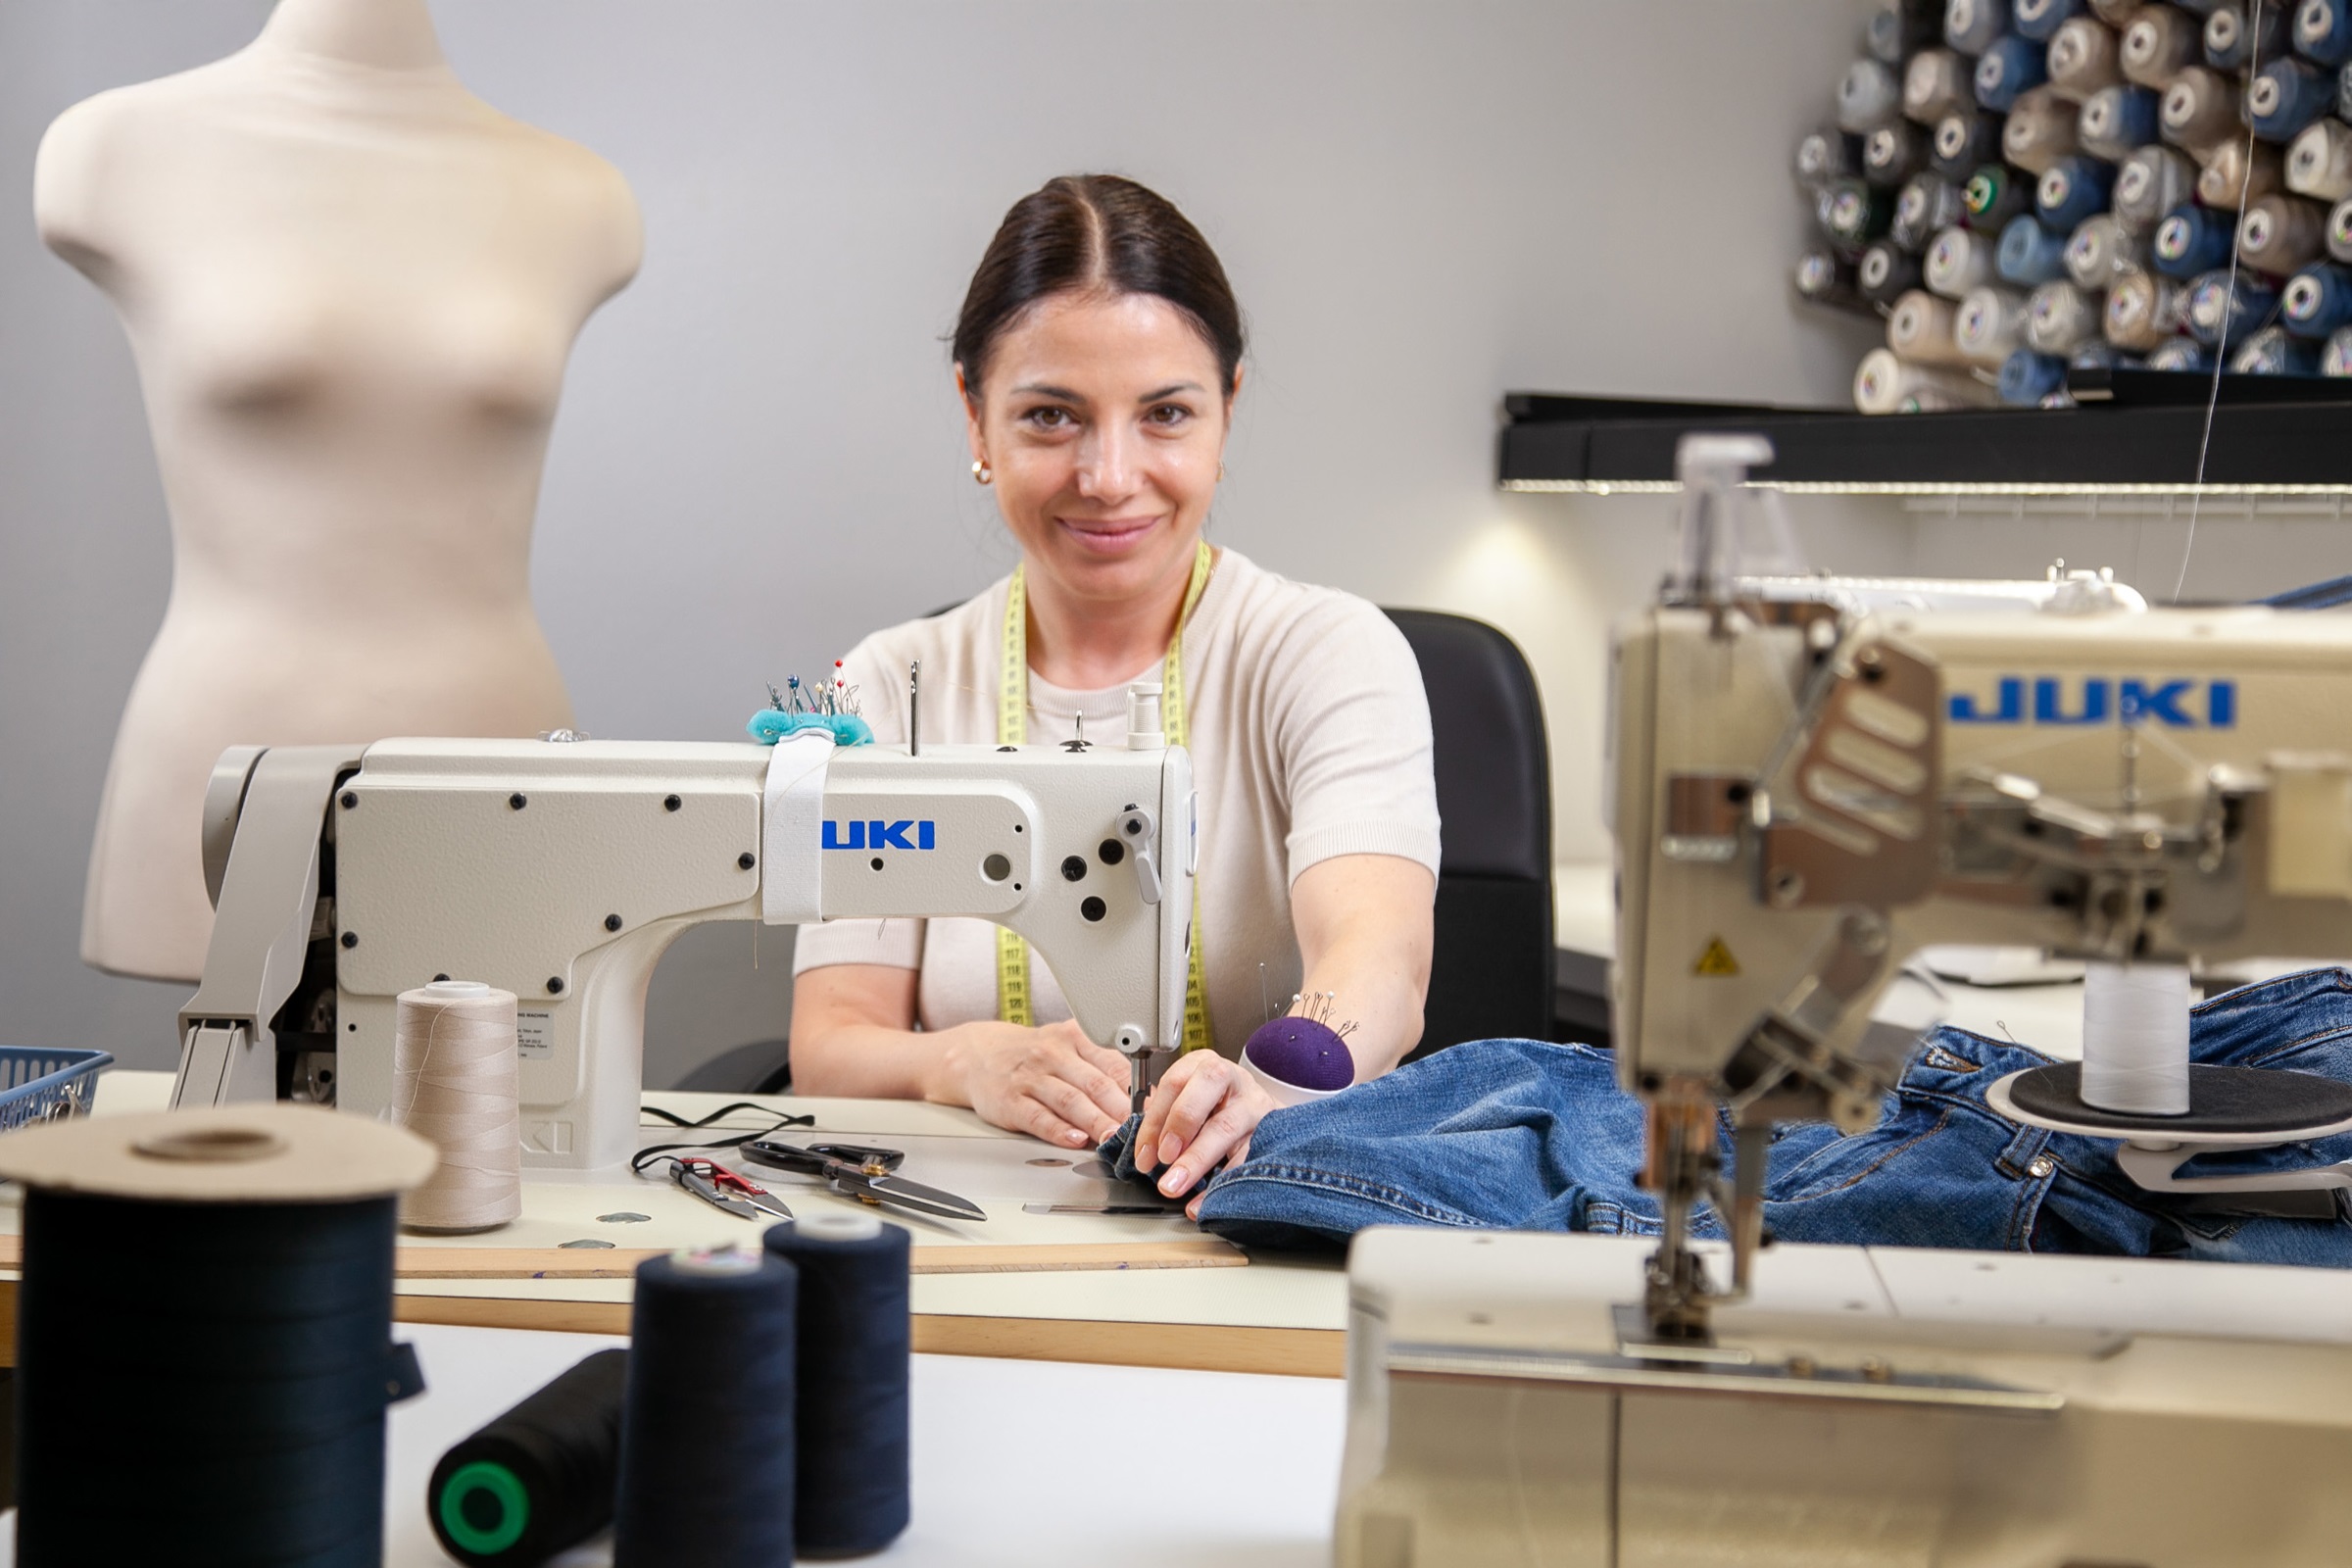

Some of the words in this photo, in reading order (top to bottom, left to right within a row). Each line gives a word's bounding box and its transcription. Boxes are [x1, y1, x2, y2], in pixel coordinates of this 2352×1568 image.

[1947, 677, 2236, 727] JUKI
[822, 820, 934, 850] UKI
[1006, 949, 1020, 958] 117
[1006, 965, 1020, 975] 118
[518, 1121, 573, 1153] KI
